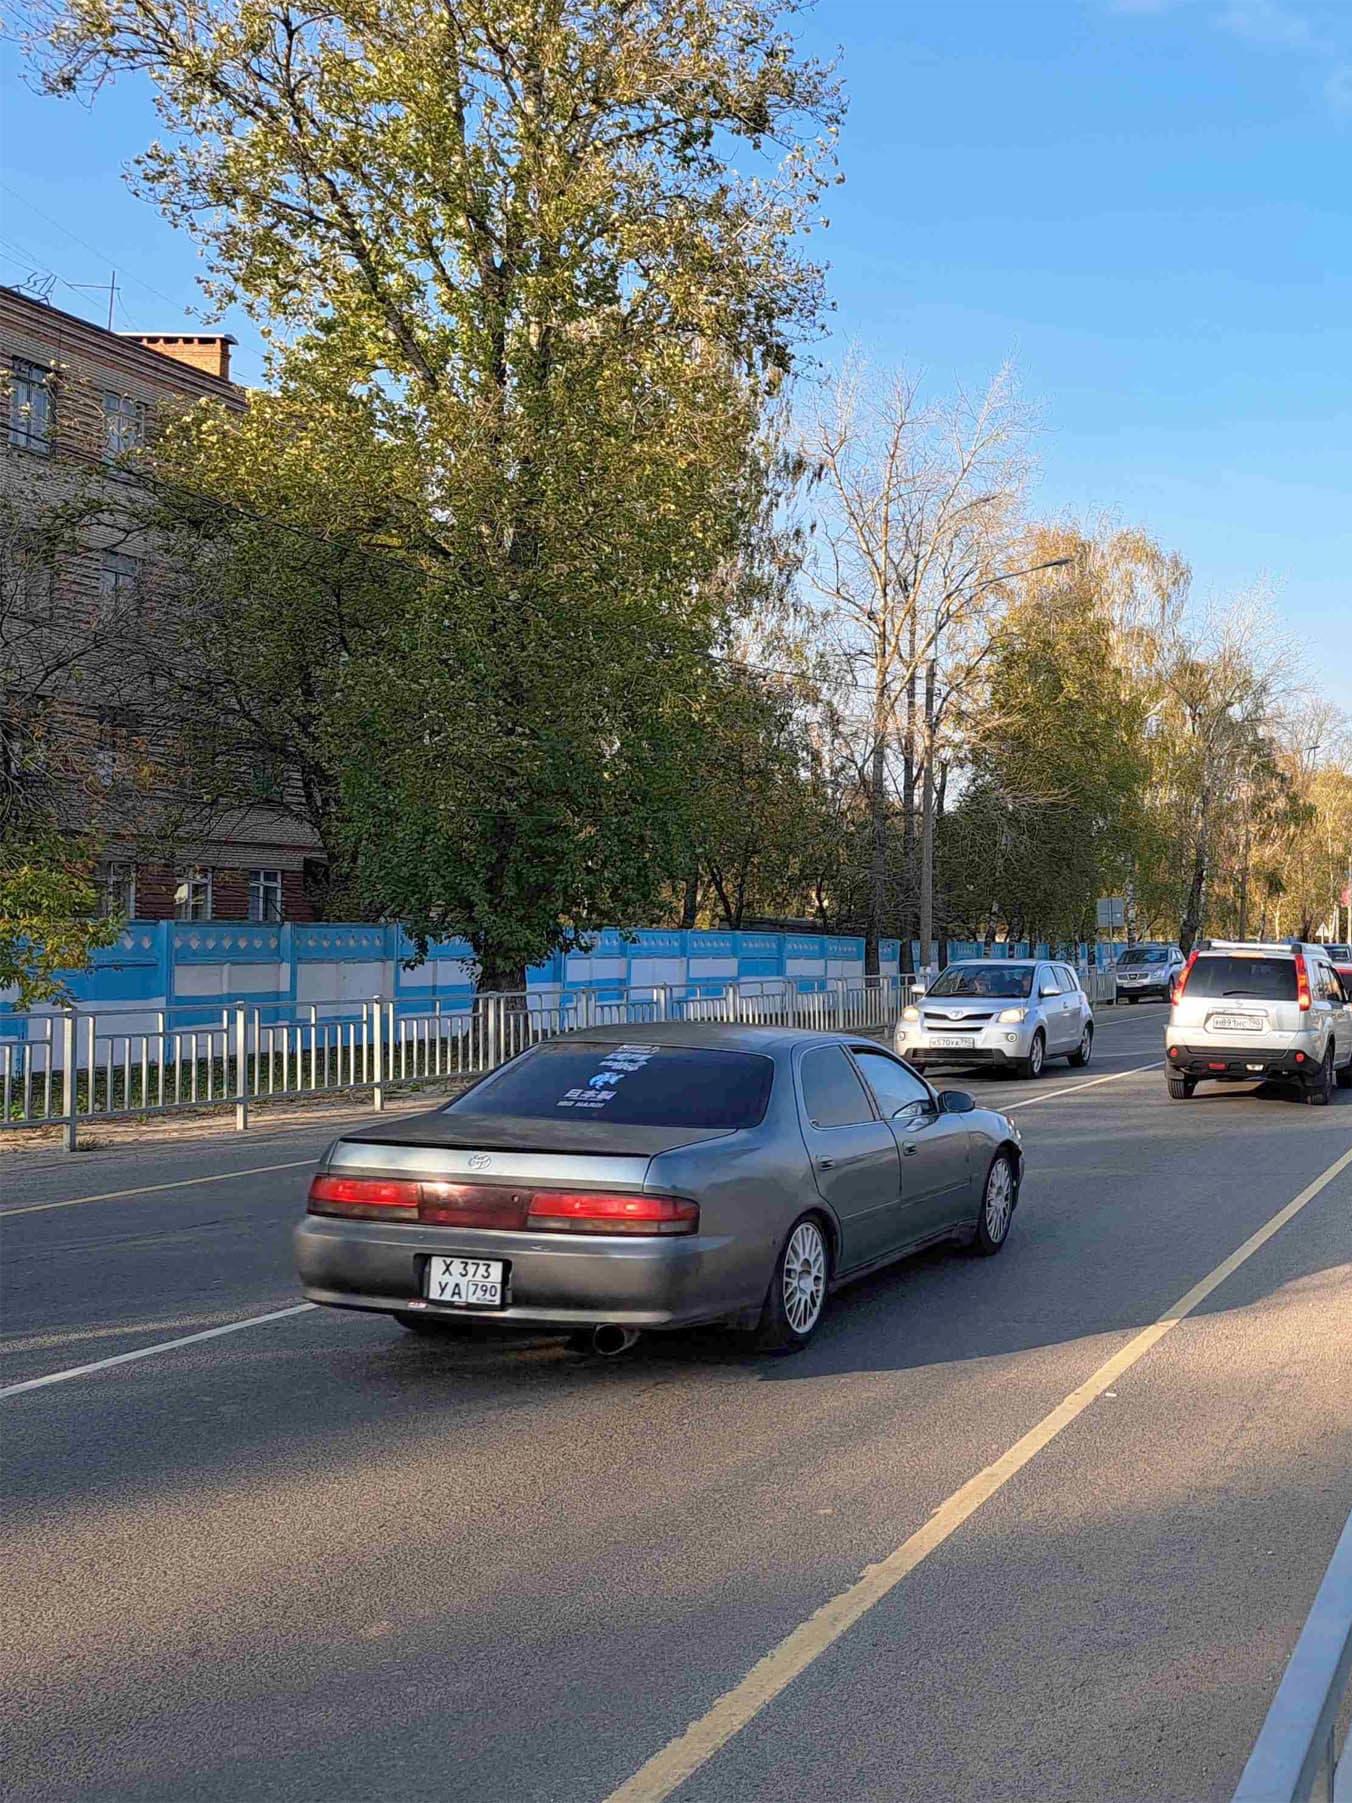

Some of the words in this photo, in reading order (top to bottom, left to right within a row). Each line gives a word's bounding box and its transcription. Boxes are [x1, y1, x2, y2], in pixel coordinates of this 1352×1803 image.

[459, 1260, 492, 1279] 373
[438, 1281, 463, 1300] УА
[471, 1283, 498, 1298] 790
